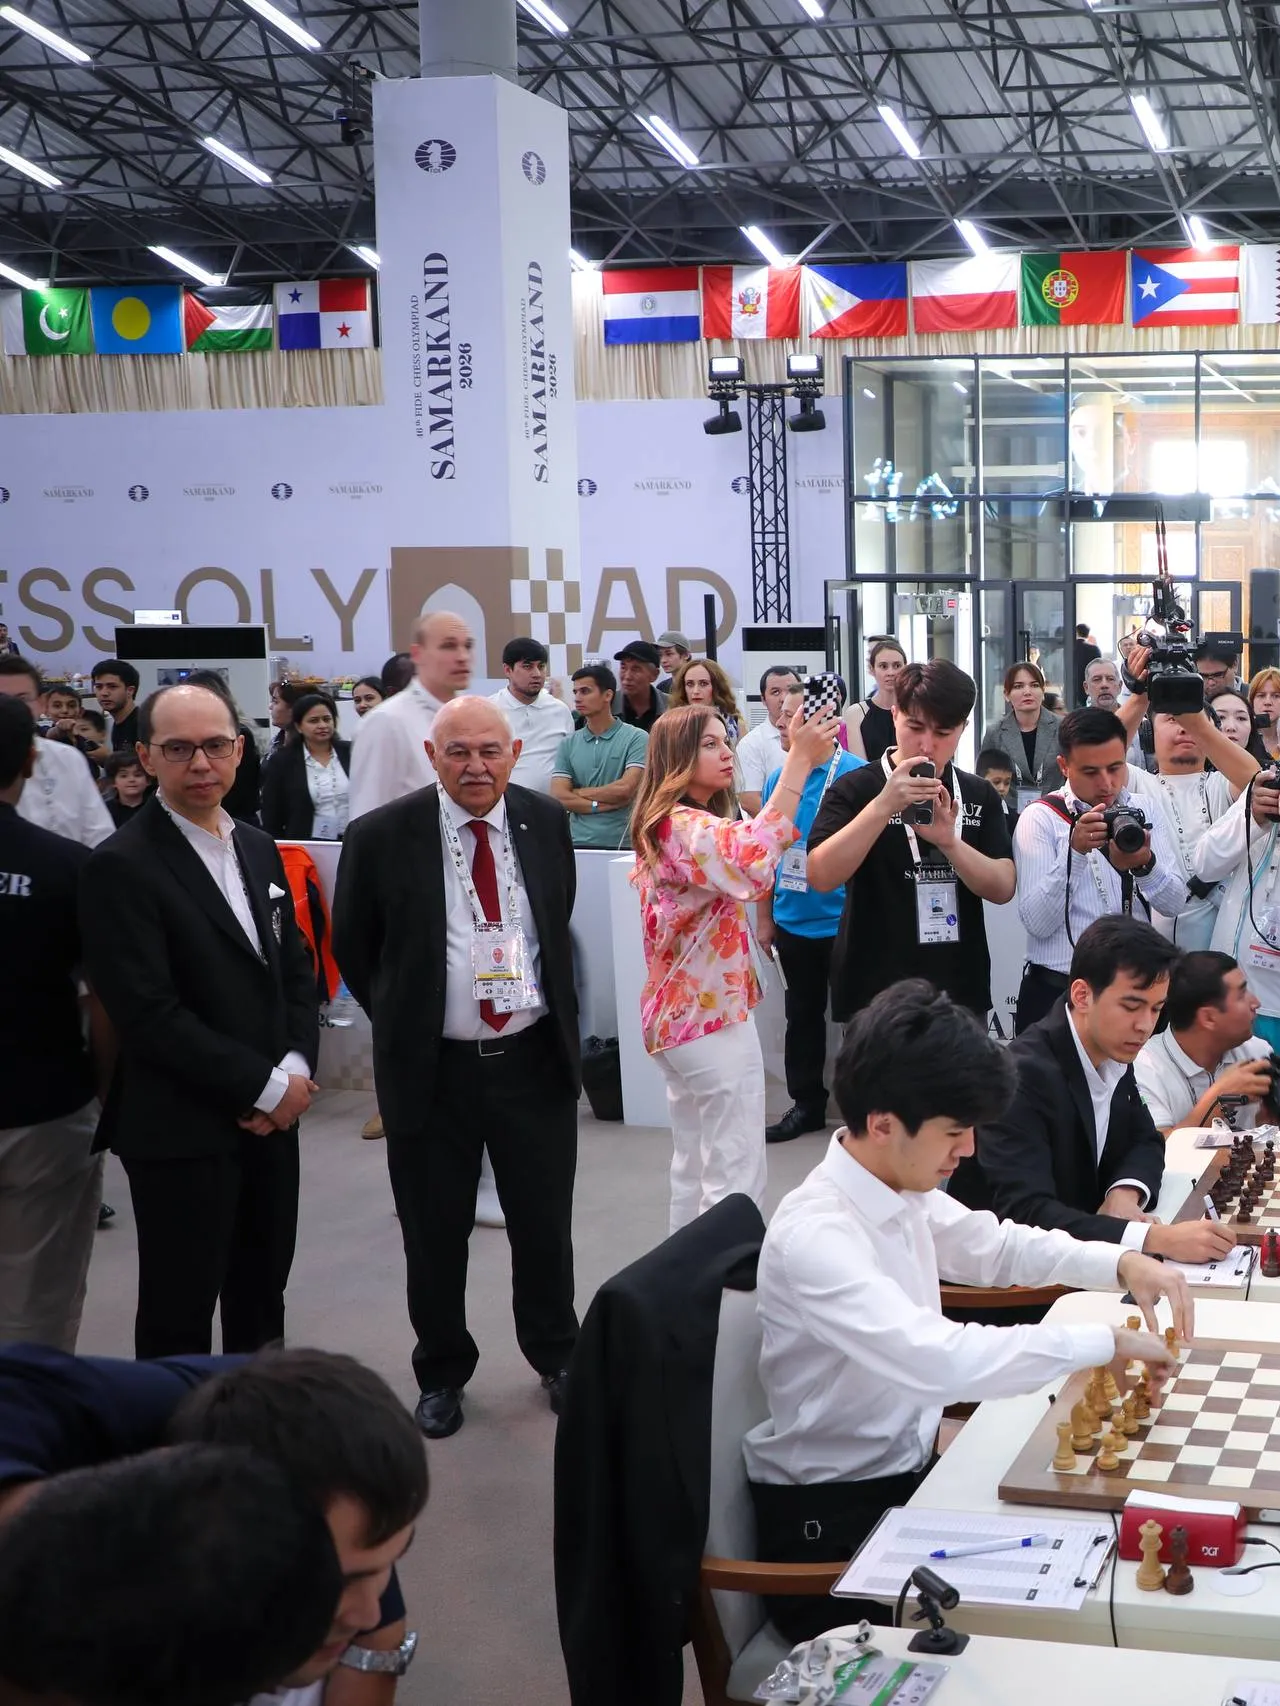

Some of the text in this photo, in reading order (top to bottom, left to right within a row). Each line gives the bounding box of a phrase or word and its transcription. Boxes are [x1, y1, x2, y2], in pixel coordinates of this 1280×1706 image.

[409, 294, 421, 352] OLYMPIAD
[412, 353, 422, 388] CHESS
[423, 252, 456, 480] SAMARKAND
[457, 342, 473, 390] 2026
[527, 260, 550, 484] SAMARKAND
[548, 353, 558, 399] 2026
[414, 392, 423, 417] FIDE
[328, 484, 383, 495] SAMARKAND
[634, 479, 692, 491] SAMARKAND
[1201, 1545, 1220, 1557] DGT
